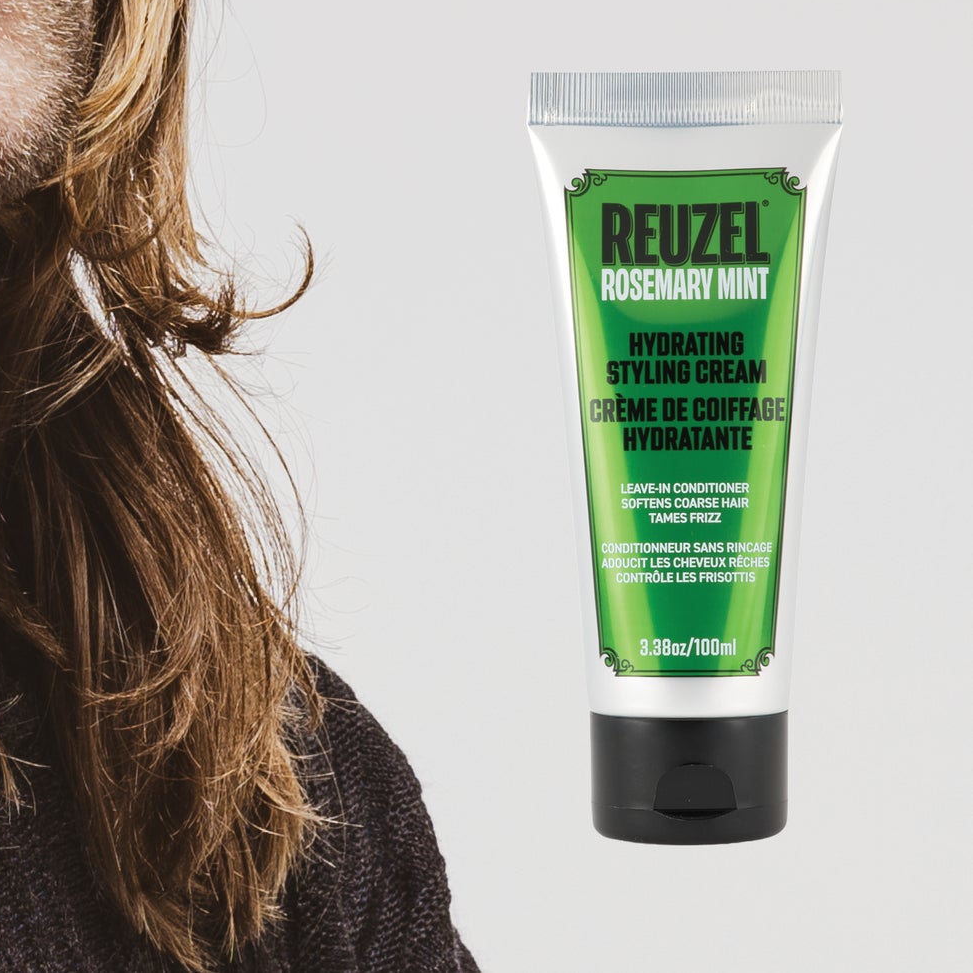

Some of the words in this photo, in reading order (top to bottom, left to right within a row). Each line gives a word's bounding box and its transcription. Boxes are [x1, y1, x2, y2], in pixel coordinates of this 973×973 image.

[601, 201, 770, 266] REUZEL
[601, 267, 713, 300] ROSEMARY
[718, 267, 769, 299] MINT
[629, 332, 744, 356] HYDRATING
[606, 360, 690, 384] STYLING
[695, 360, 766, 384] CREAM
[590, 394, 657, 422] CRÈME
[663, 398, 689, 422] DE
[693, 397, 784, 422] COIFFAGE
[623, 427, 752, 451] HYDRATANTE
[621, 483, 670, 494] LEAVE-IN
[673, 483, 749, 493] CONDITIONER
[621, 498, 672, 509] SOFTENS
[674, 498, 719, 508] COARSE
[721, 498, 749, 508] HAIR
[649, 513, 688, 524] TAMES
[690, 513, 721, 523] FRIZZ
[602, 543, 691, 553] CONDITIONNEUR
[693, 542, 724, 553] SANS
[726, 542, 772, 553] RINCAGE
[602, 557, 648, 568] ADOUCIT
[650, 557, 671, 568] LES
[673, 557, 726, 568] CHEVEUX
[728, 554, 769, 568] RÊCHES
[616, 569, 673, 583] CONTRÔLE
[676, 572, 696, 583] LES
[699, 572, 755, 583] FRISOTTIS
[640, 638, 736, 656] 3.38oz/100ml
